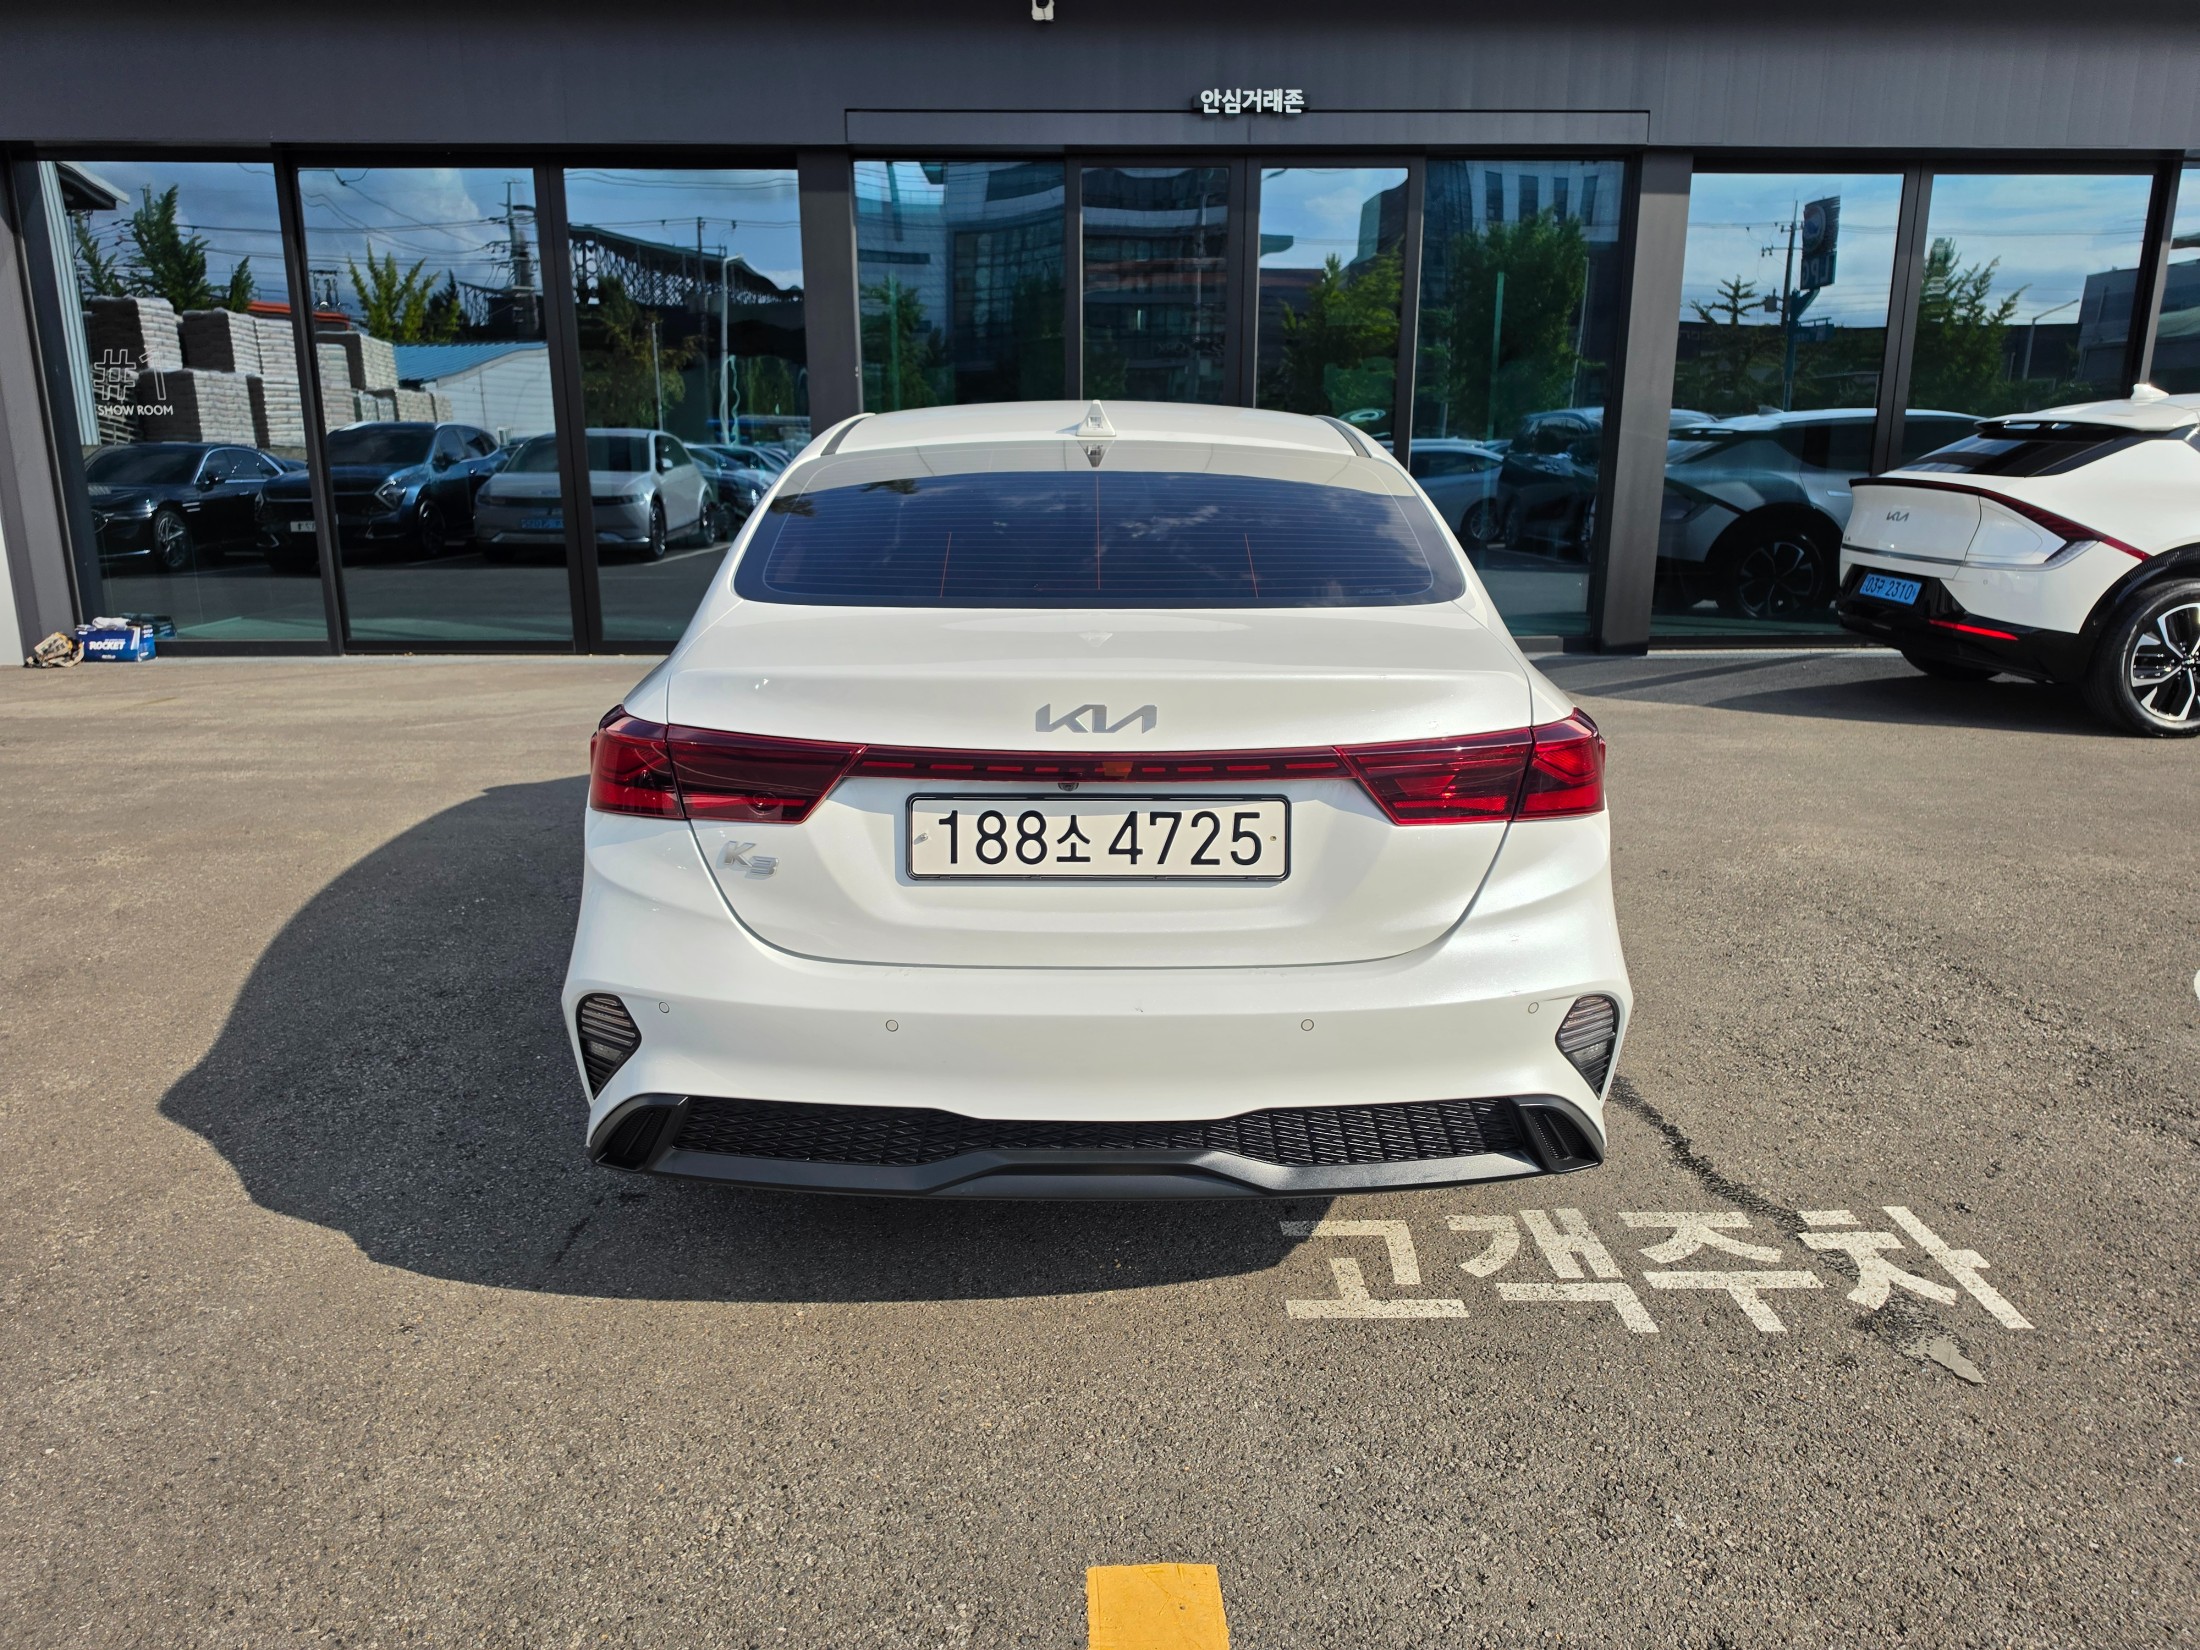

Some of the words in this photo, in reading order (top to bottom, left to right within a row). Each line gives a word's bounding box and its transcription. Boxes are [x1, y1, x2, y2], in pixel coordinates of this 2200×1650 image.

[1200, 88, 1305, 114] 안심거래존
[94, 348, 167, 400] #1
[98, 405, 134, 416] SHOW
[137, 405, 174, 416] ROOM
[1885, 580, 1914, 601] 2310
[89, 641, 127, 651] ROCKET
[1035, 704, 1158, 734] KIA
[939, 810, 1091, 865] 188소
[1109, 811, 1262, 866] 4725
[717, 840, 780, 879] K3
[1280, 1206, 2035, 1333] 고객주차
